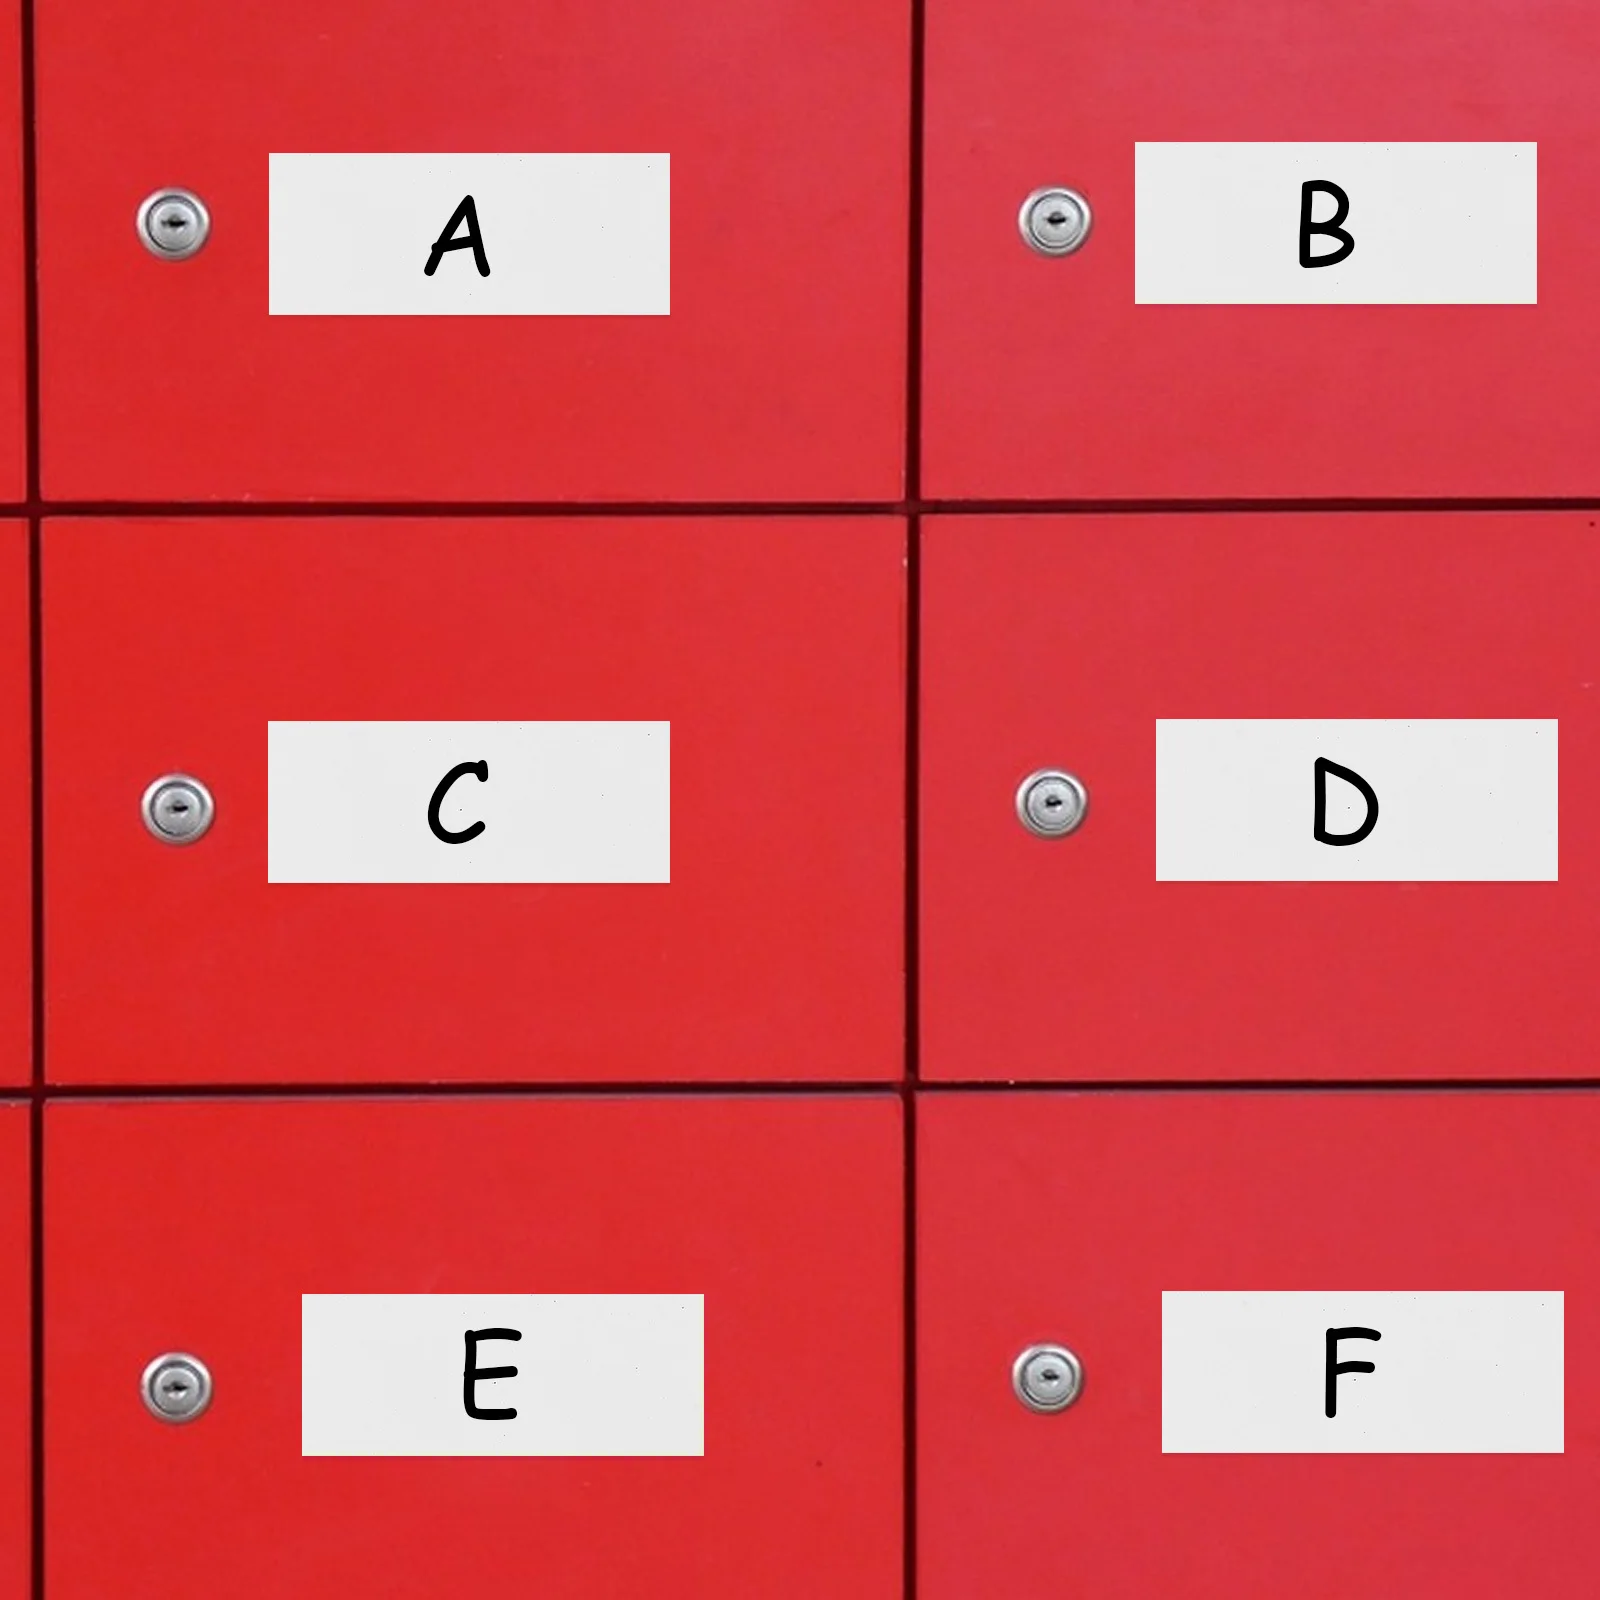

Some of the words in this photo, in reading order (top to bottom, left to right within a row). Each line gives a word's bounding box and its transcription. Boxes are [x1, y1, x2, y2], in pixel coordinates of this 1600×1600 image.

[423, 195, 491, 278] A
[1299, 180, 1355, 269] B
[428, 760, 489, 845] C
[1314, 757, 1379, 847] D
[463, 1328, 523, 1421] E
[1325, 1327, 1382, 1419] F
